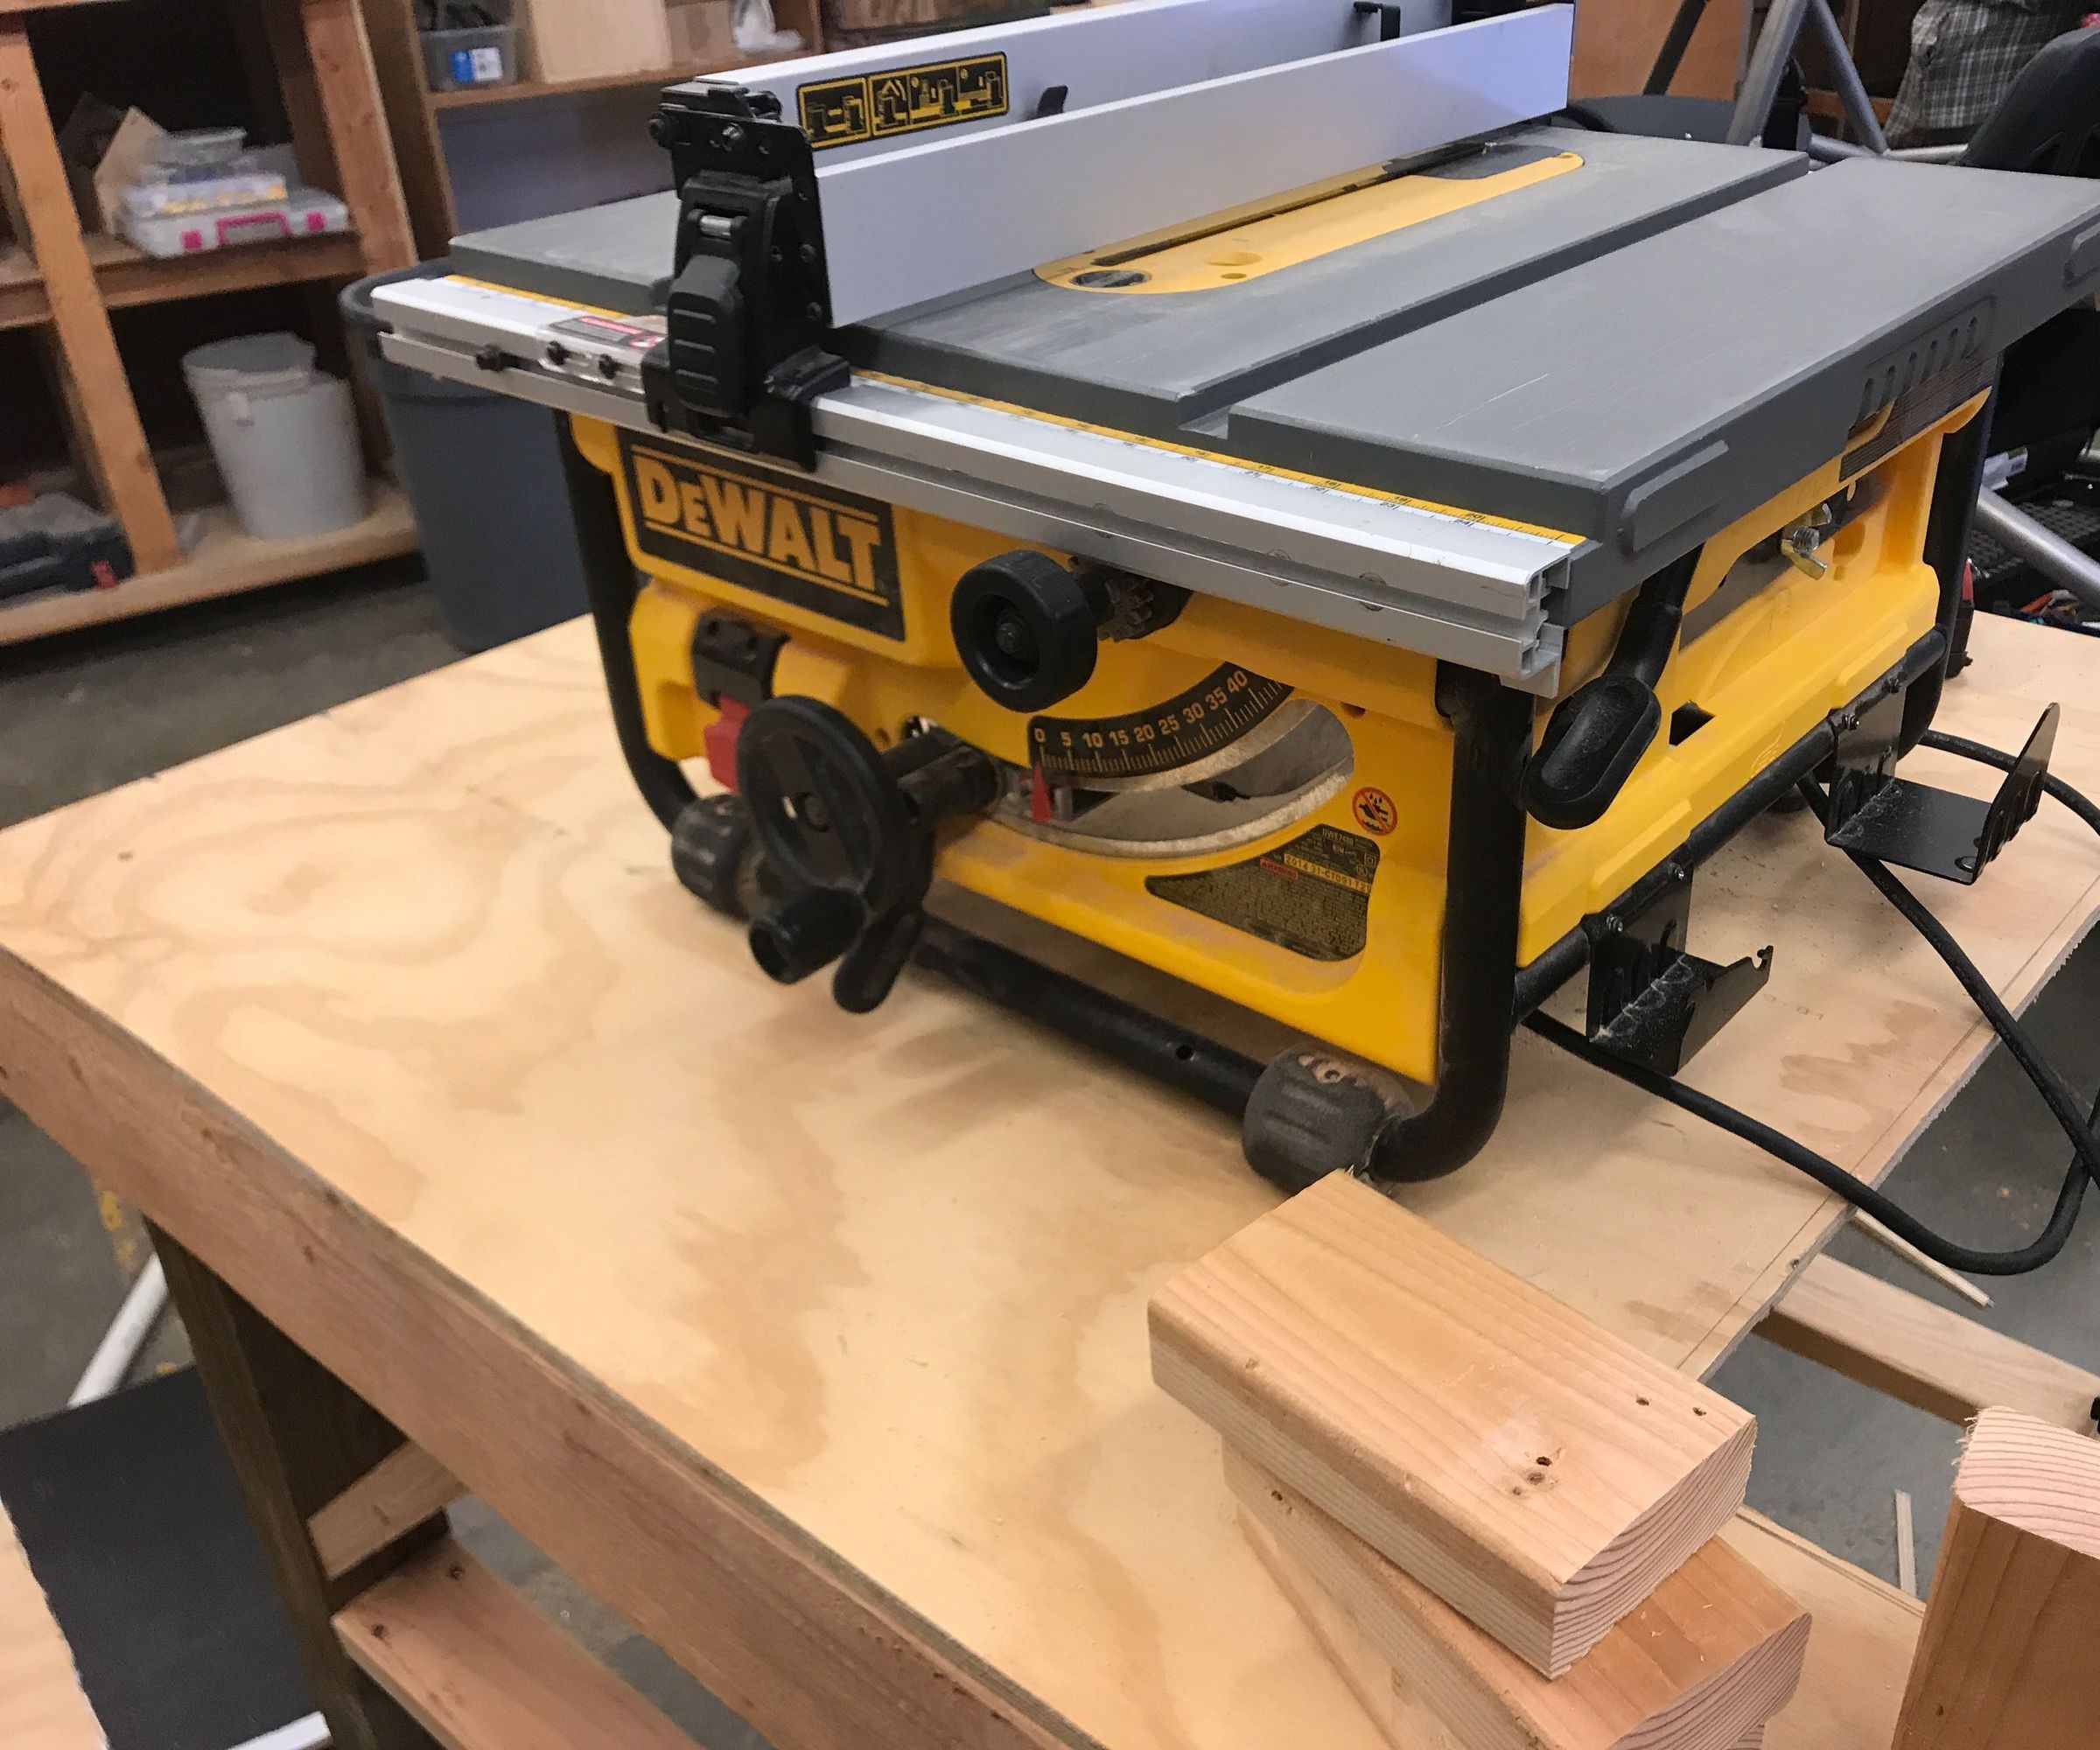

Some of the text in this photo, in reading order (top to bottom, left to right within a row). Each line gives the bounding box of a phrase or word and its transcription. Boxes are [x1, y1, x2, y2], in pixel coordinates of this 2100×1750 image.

[633, 454, 881, 592] DEWALT
[1033, 670, 1248, 748] 0 5 10 15 20 25 30 35 40
